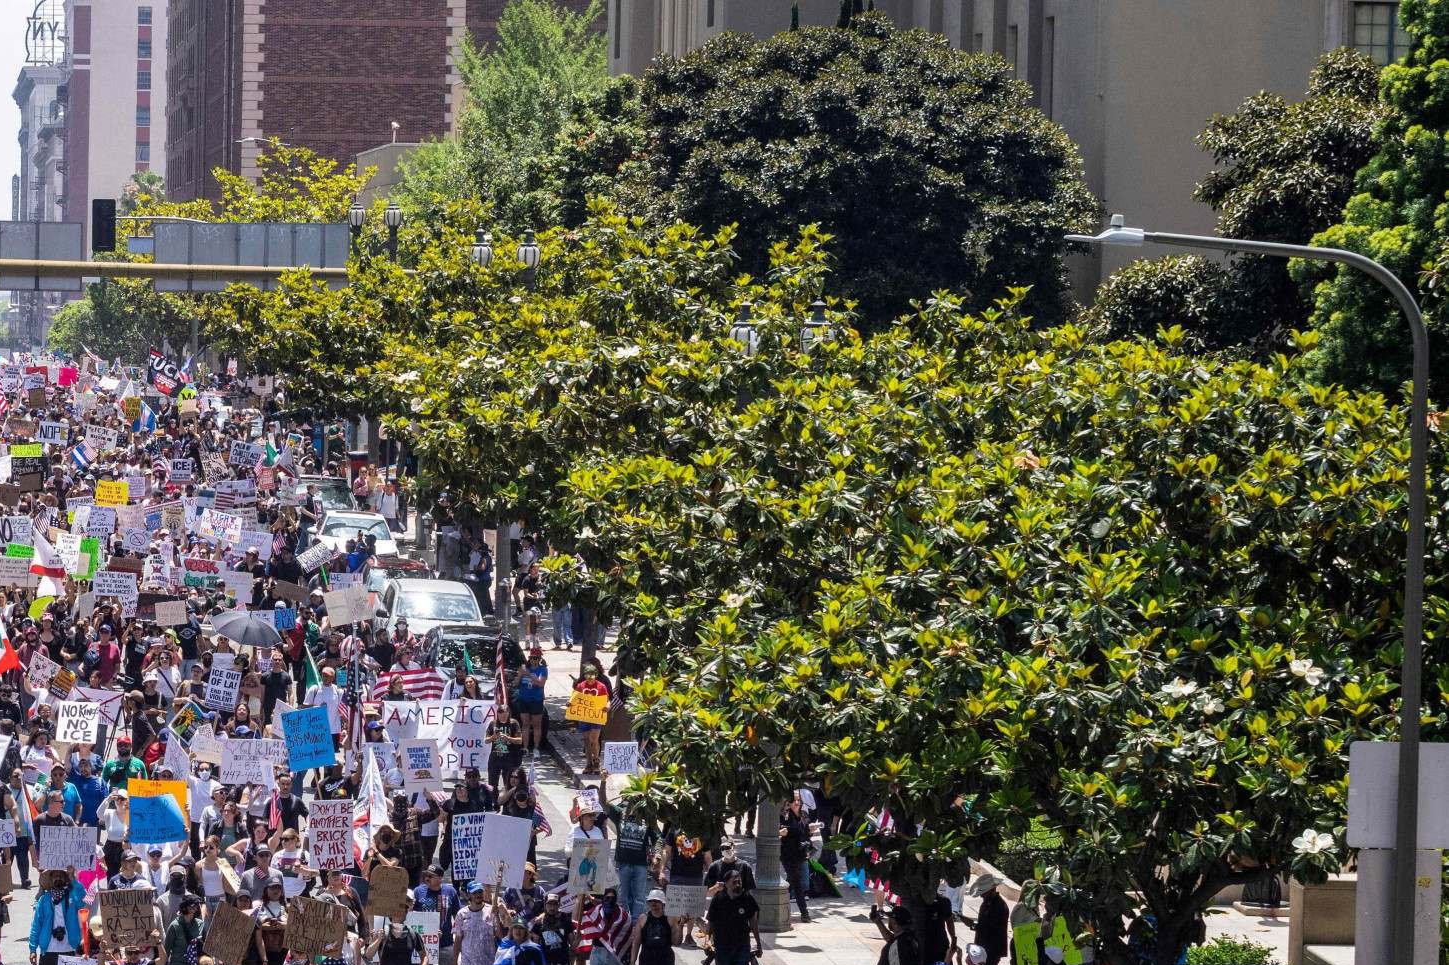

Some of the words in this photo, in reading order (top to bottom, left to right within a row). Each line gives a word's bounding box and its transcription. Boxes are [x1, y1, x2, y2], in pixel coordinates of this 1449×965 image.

[172, 461, 190, 471] ICE:
[212, 669, 224, 678] ICE
[226, 673, 240, 681] OUT
[61, 704, 77, 718] NO
[387, 705, 497, 727] AMERICA
[66, 719, 88, 730] NO
[63, 730, 92, 742] ICE
[448, 738, 484, 749] YOUR
[341, 803, 353, 814] BE
[317, 831, 348, 841] BRICK
[314, 844, 324, 855] IN
[328, 842, 347, 855] HIS
[454, 838, 482, 848] FAMILY
[318, 857, 352, 870] WALL
[131, 905, 141, 917] A
